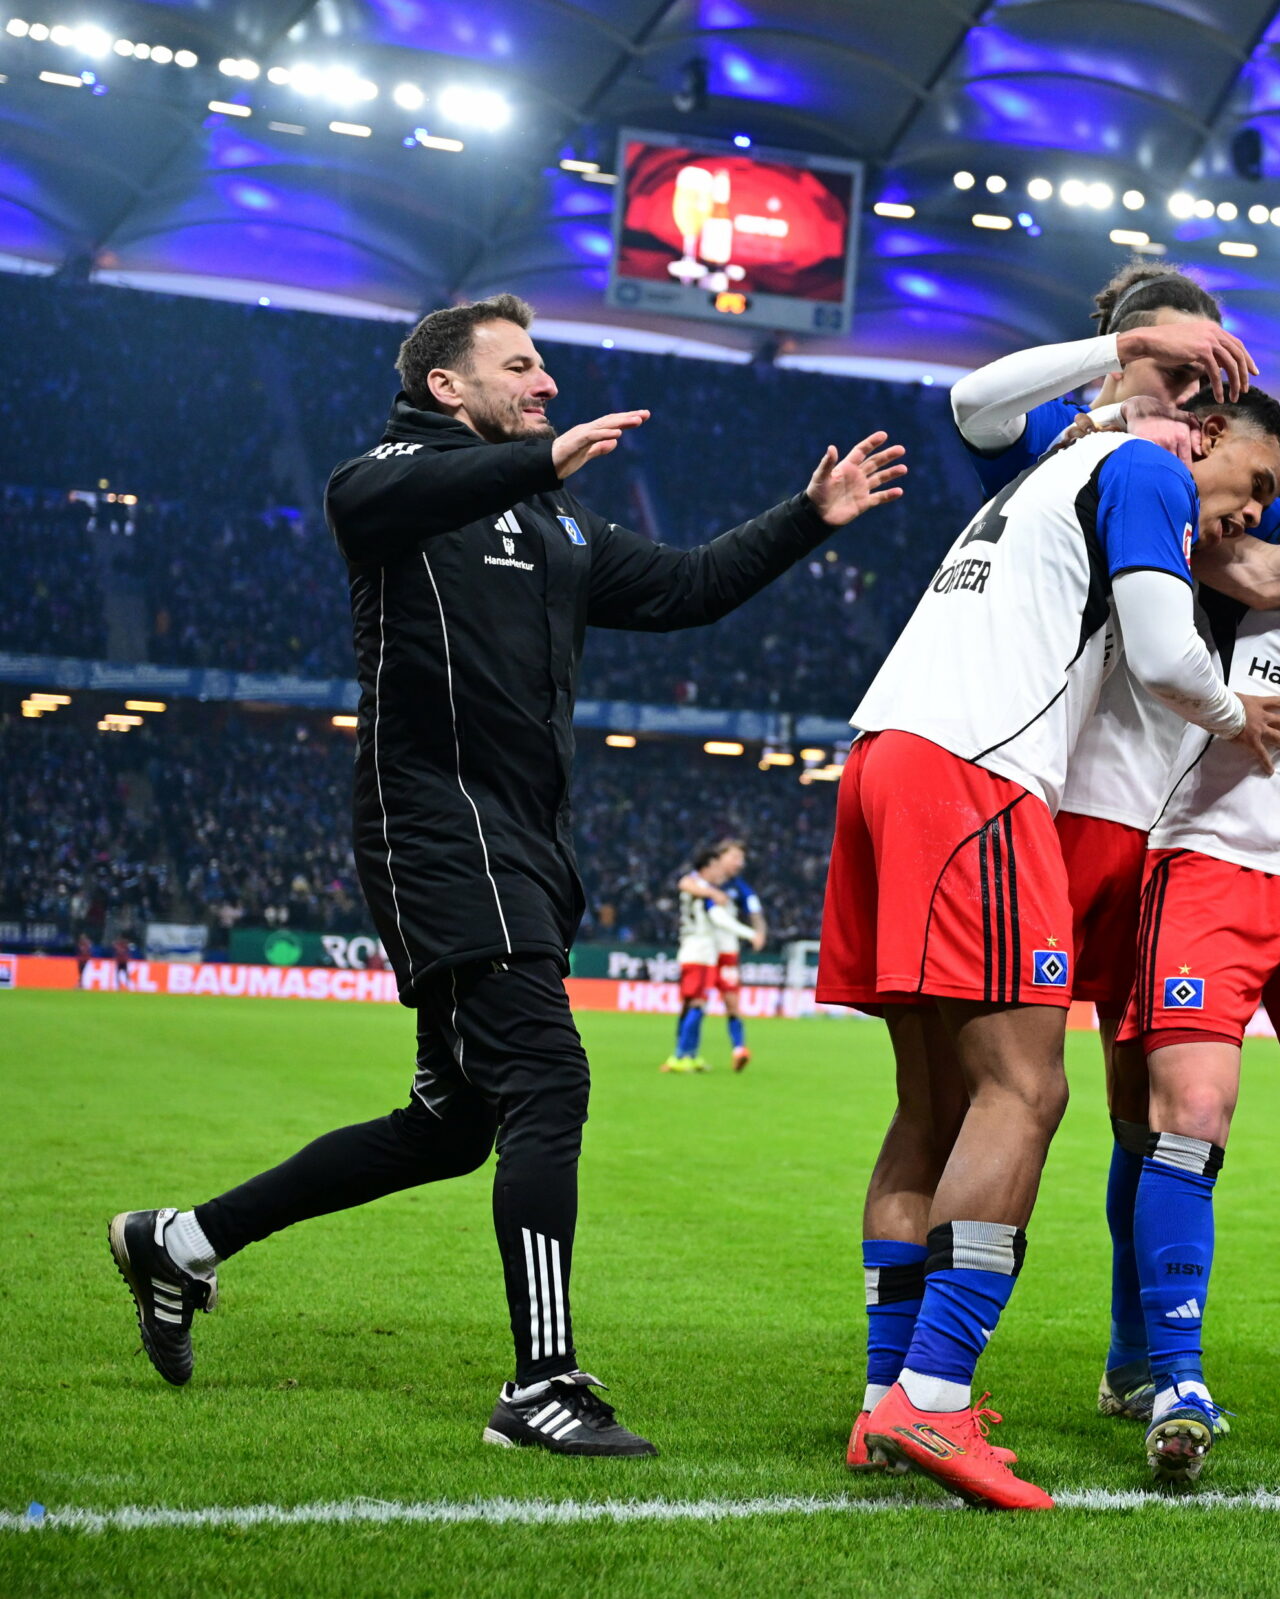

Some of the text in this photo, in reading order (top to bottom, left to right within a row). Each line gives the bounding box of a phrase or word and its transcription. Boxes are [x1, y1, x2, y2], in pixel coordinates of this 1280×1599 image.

[484, 555, 534, 571] HanseMerkur
[320, 934, 395, 971] RO
[167, 964, 398, 1001] BAUMASCHI
[1165, 1262, 1204, 1277] HSV
